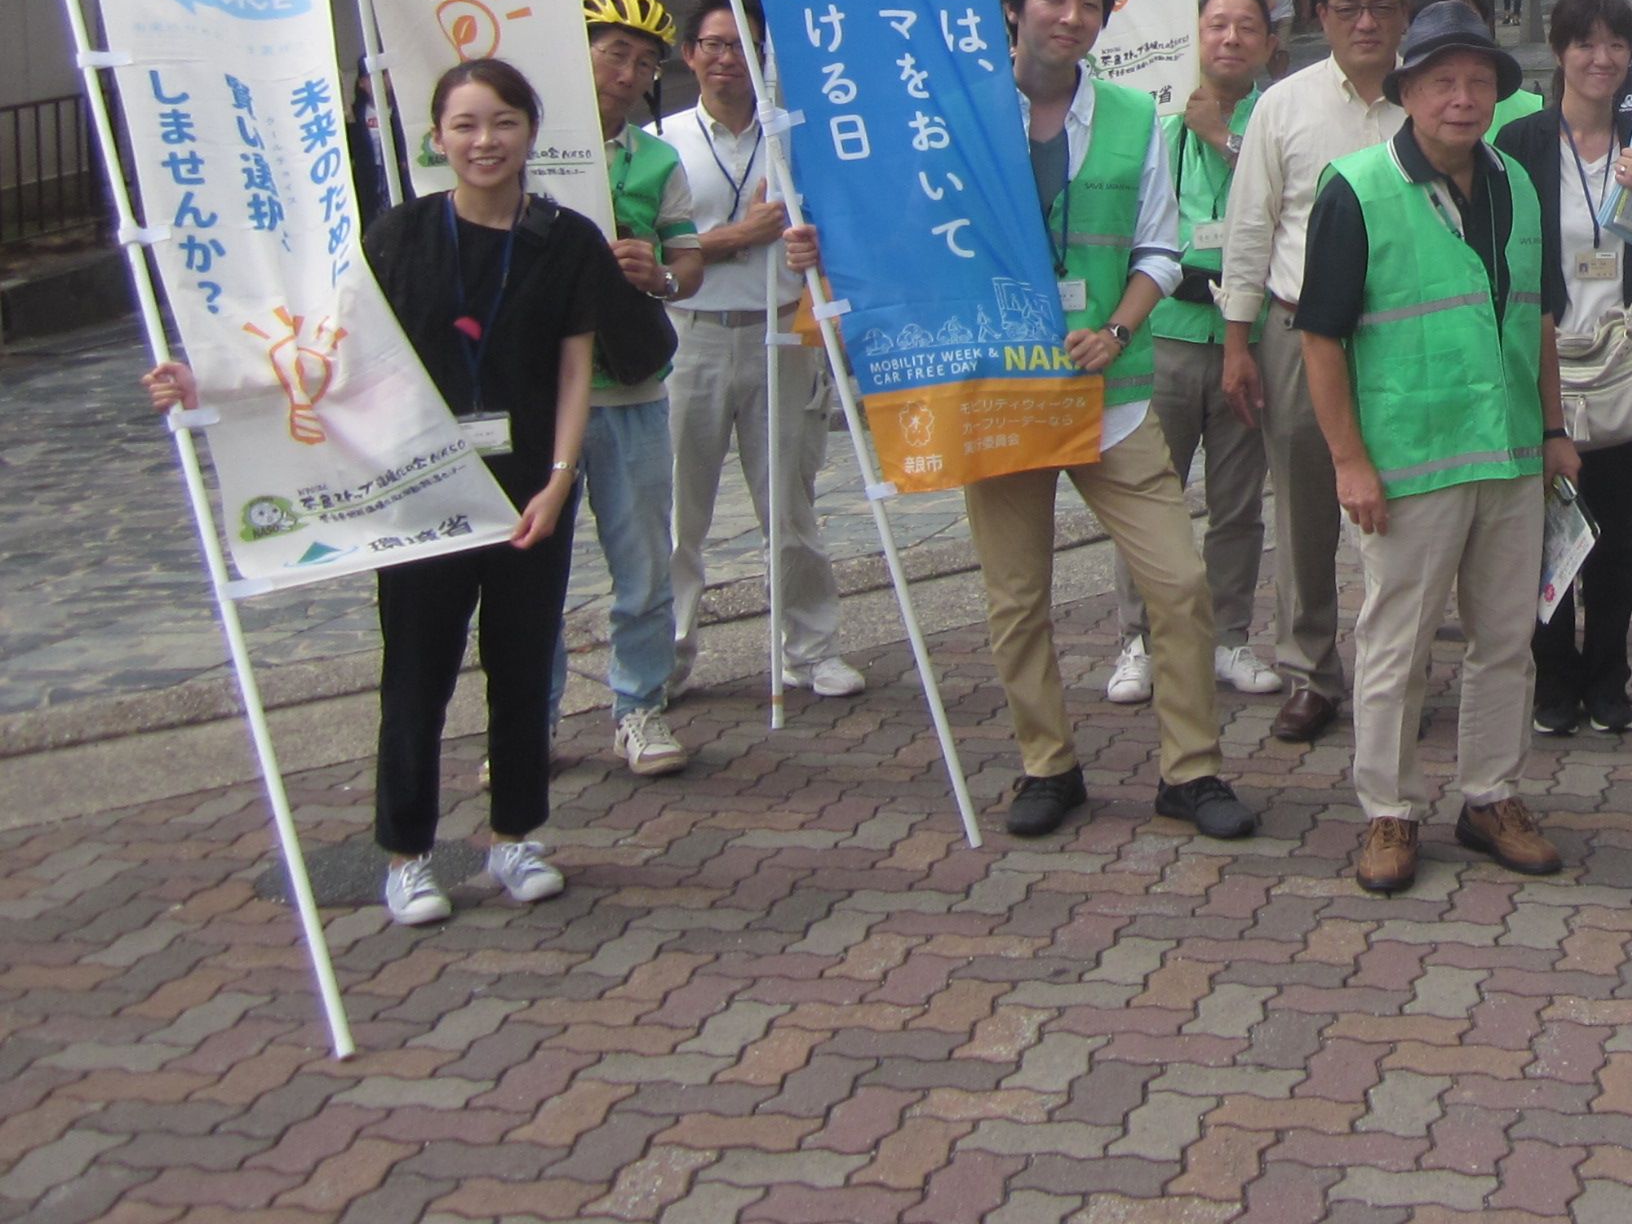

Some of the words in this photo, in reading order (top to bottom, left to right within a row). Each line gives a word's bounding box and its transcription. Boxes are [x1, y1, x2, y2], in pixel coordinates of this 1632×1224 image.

[1149, 85, 1173, 105] 省
[149, 69, 226, 314] しませんか？
[290, 76, 353, 289] 未来のために
[870, 352, 936, 374] MOBILITY
[941, 347, 983, 363] WEEK
[988, 347, 999, 359] &
[1004, 344, 1085, 371] NAR
[873, 369, 901, 386] CAR
[907, 366, 946, 381] FREE
[951, 361, 979, 376] DAY
